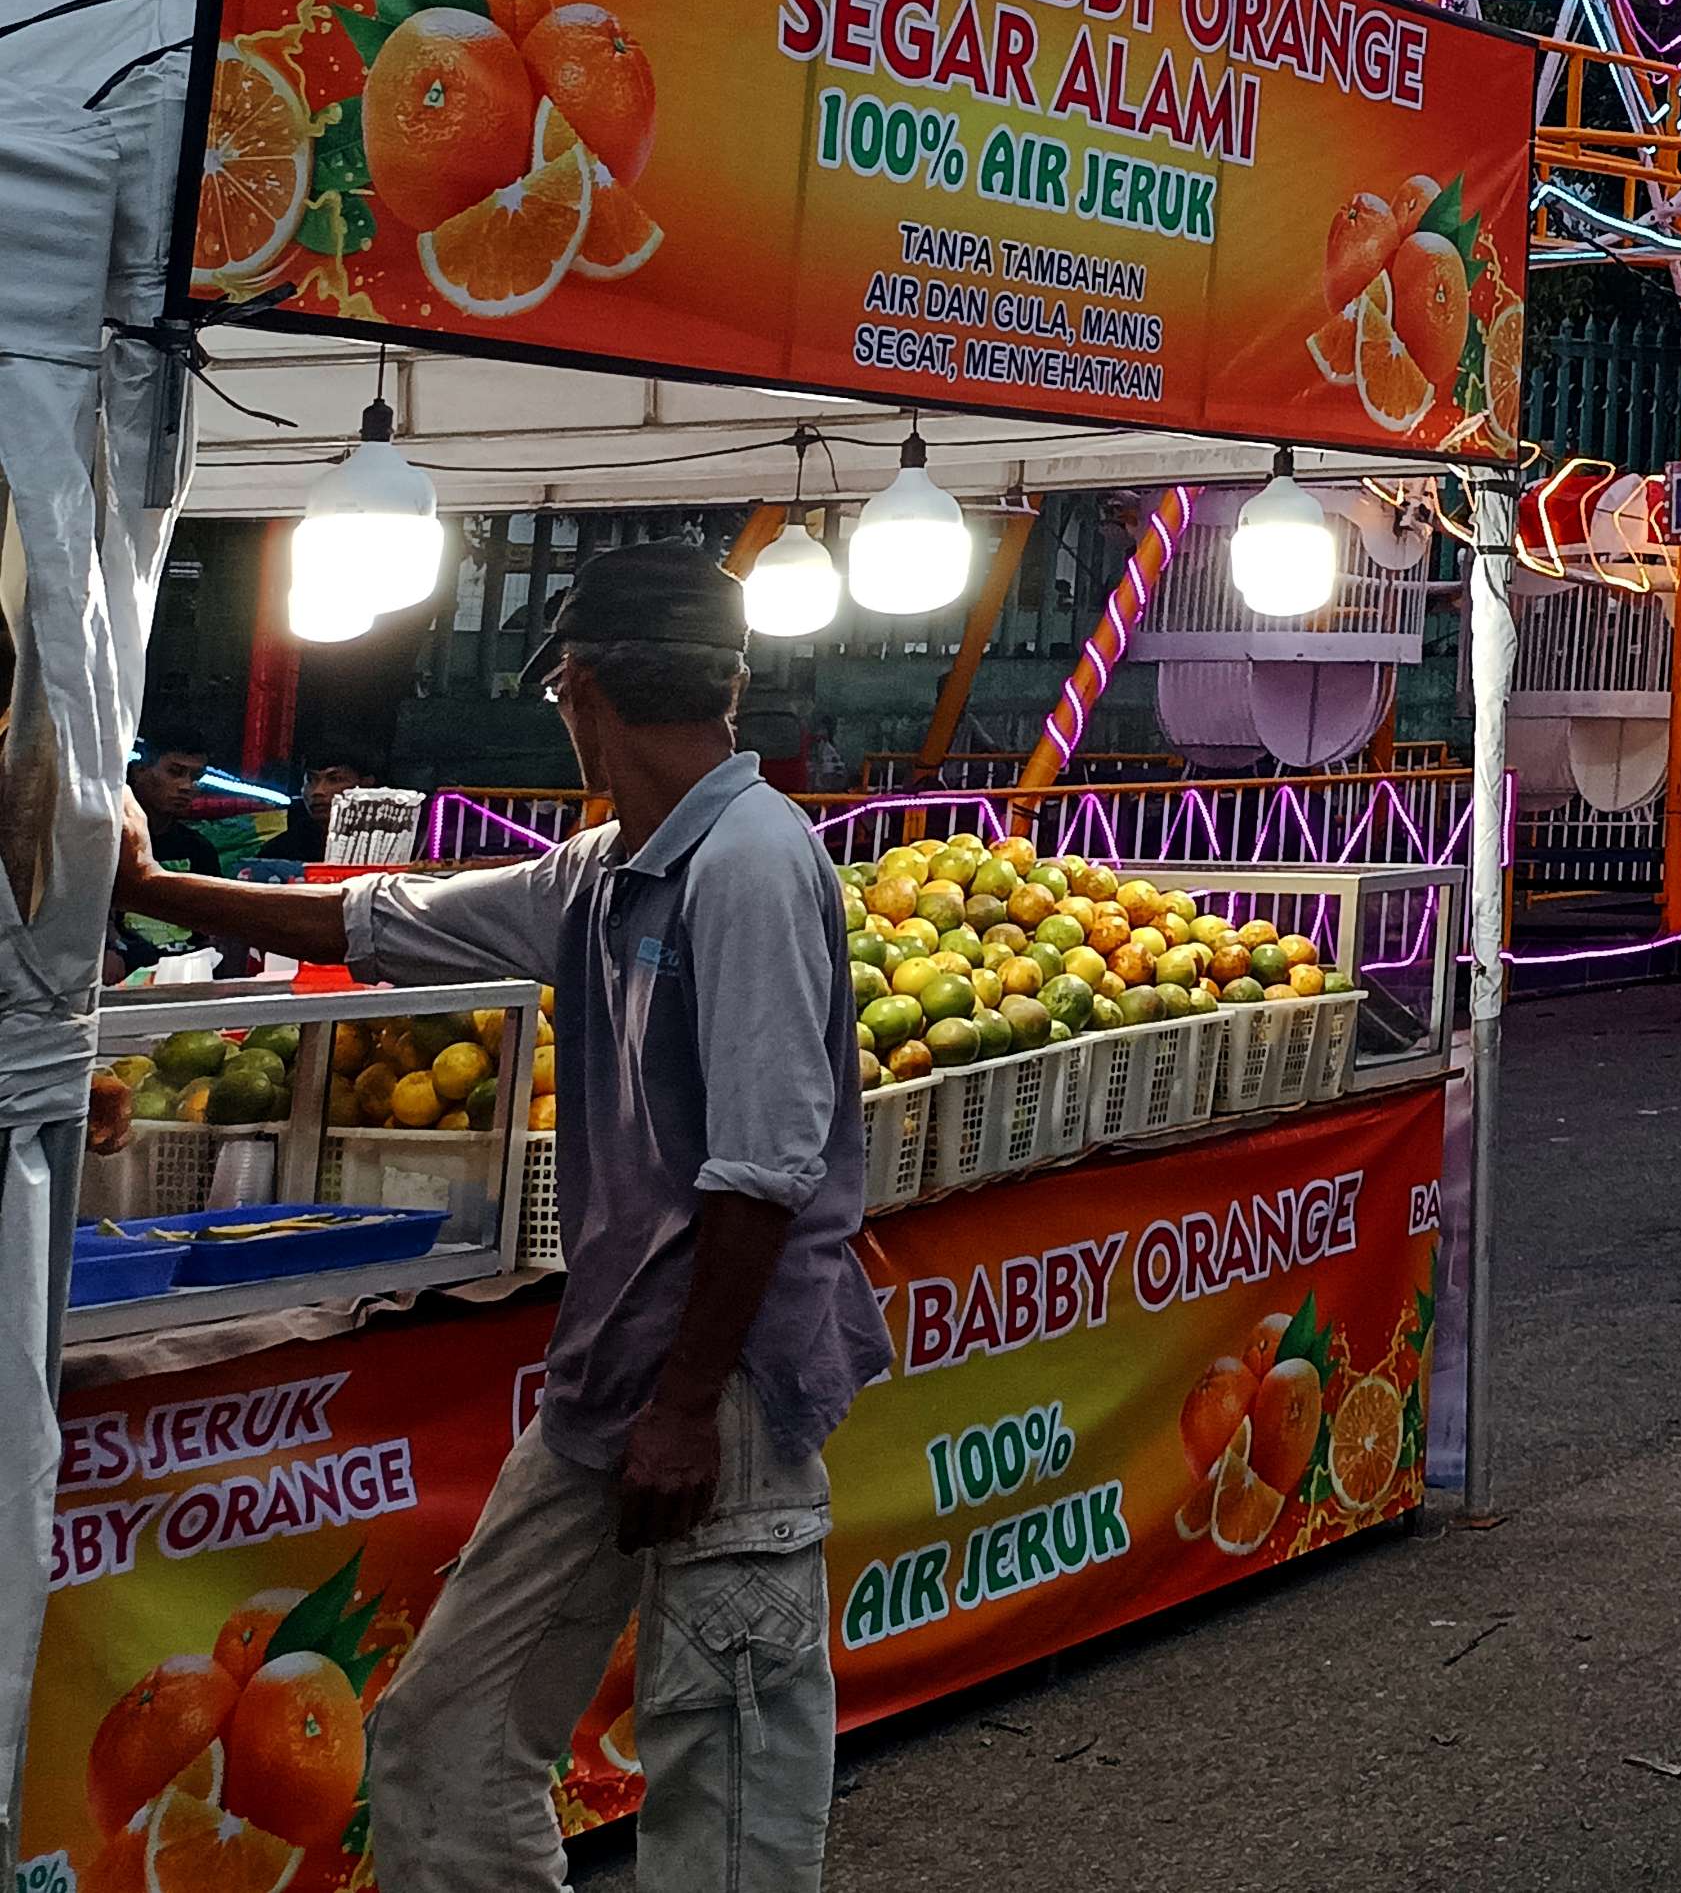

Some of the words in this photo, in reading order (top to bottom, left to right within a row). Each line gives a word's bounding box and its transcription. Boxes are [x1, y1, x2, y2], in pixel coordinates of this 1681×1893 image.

[1051, 24, 1261, 167] ALAMI
[818, 87, 968, 191] 100%
[976, 124, 1071, 212] AIR
[1074, 149, 1218, 243] JERUK
[864, 271, 919, 314] AIR
[924, 282, 987, 327] DAN
[993, 293, 1076, 345] GULA,
[1081, 308, 1162, 353] MANIS
[899, 222, 993, 275] TANPA
[1000, 240, 1146, 301] TAMBAHAN
[853, 323, 958, 383] SEGAT,
[963, 339, 1164, 401] MENYEHATKAN
[904, 1231, 1129, 1374] BABBY
[1133, 1170, 1364, 1312] ORANGE
[56, 1411, 137, 1494] ES
[138, 1371, 352, 1480] JERUK
[927, 1400, 1075, 1515] 100%
[49, 1491, 175, 1592] BBY
[159, 1437, 417, 1560] ORANGE
[842, 1542, 950, 1650] AIR
[955, 1480, 1130, 1611] JERUK
